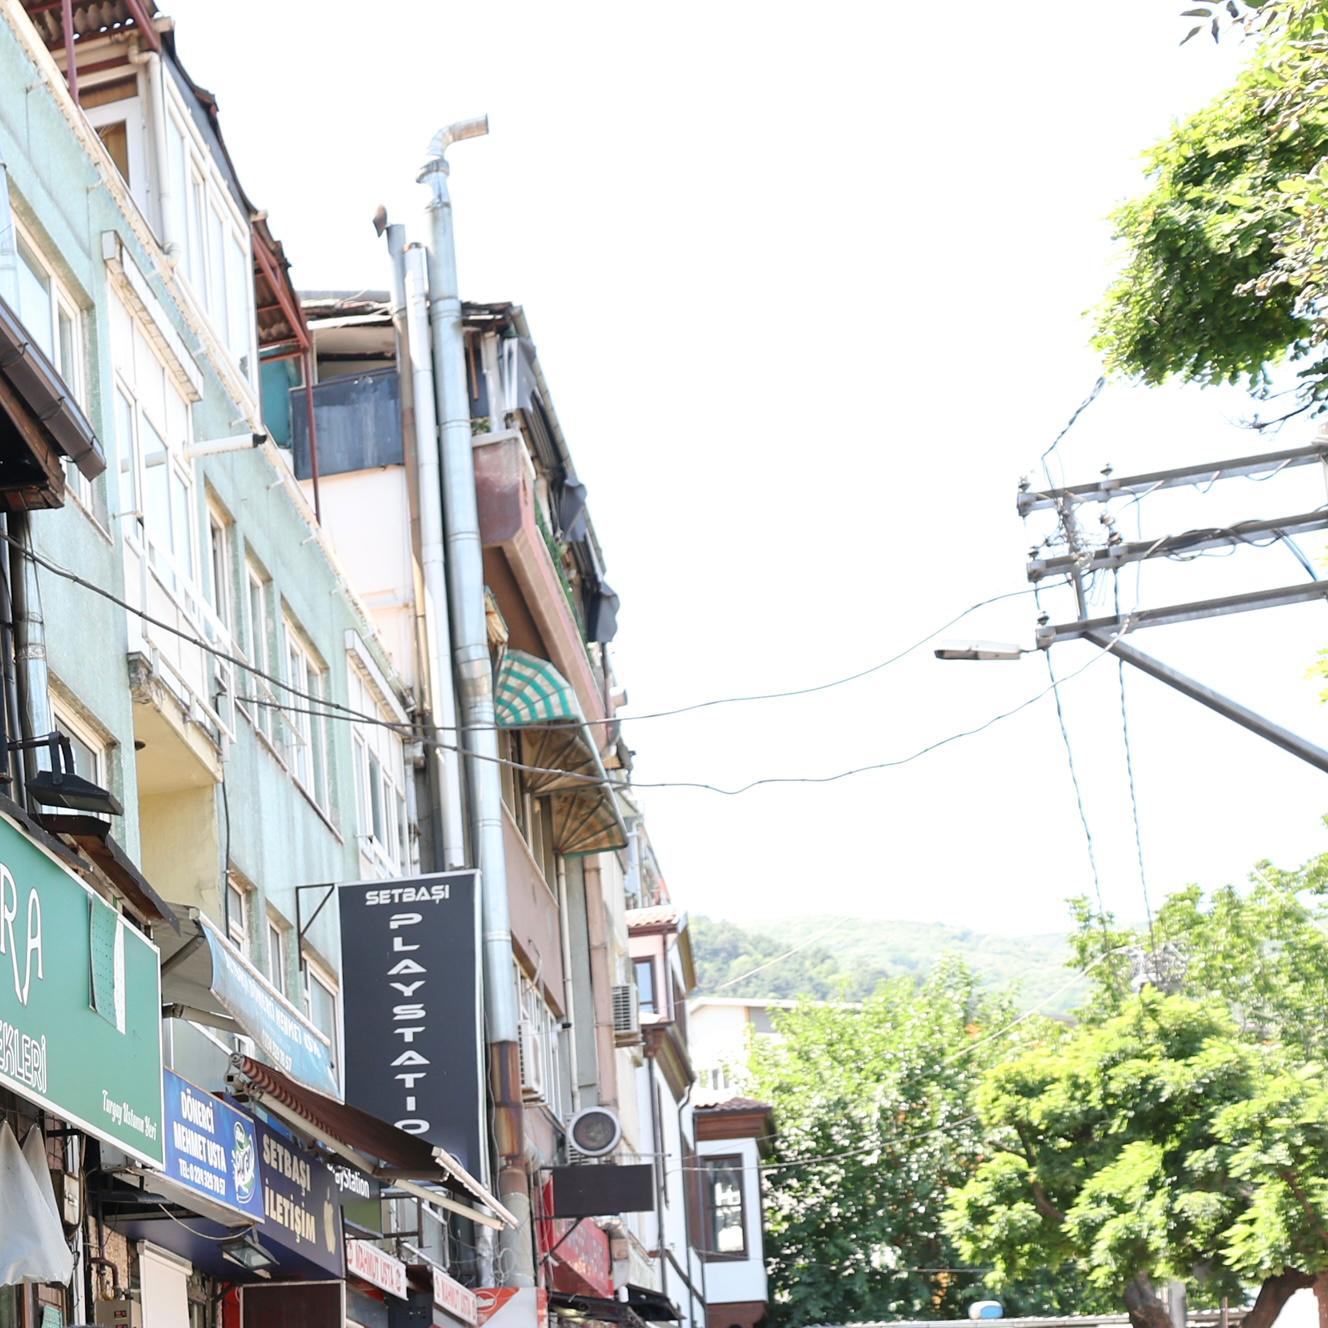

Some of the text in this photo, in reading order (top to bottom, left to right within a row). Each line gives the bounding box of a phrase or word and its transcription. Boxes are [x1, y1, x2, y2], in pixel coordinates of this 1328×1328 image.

[365, 884, 450, 905] SETBAŞI
[387, 912, 431, 1135] PLAYSTATIO
[180, 1088, 214, 1134] DÖNERCİ
[173, 1120, 207, 1163] MEHMET
[207, 1139, 227, 1173] USTA
[263, 1133, 311, 1198] SETBAŞI
[264, 1178, 317, 1244] İLETİŞİM
